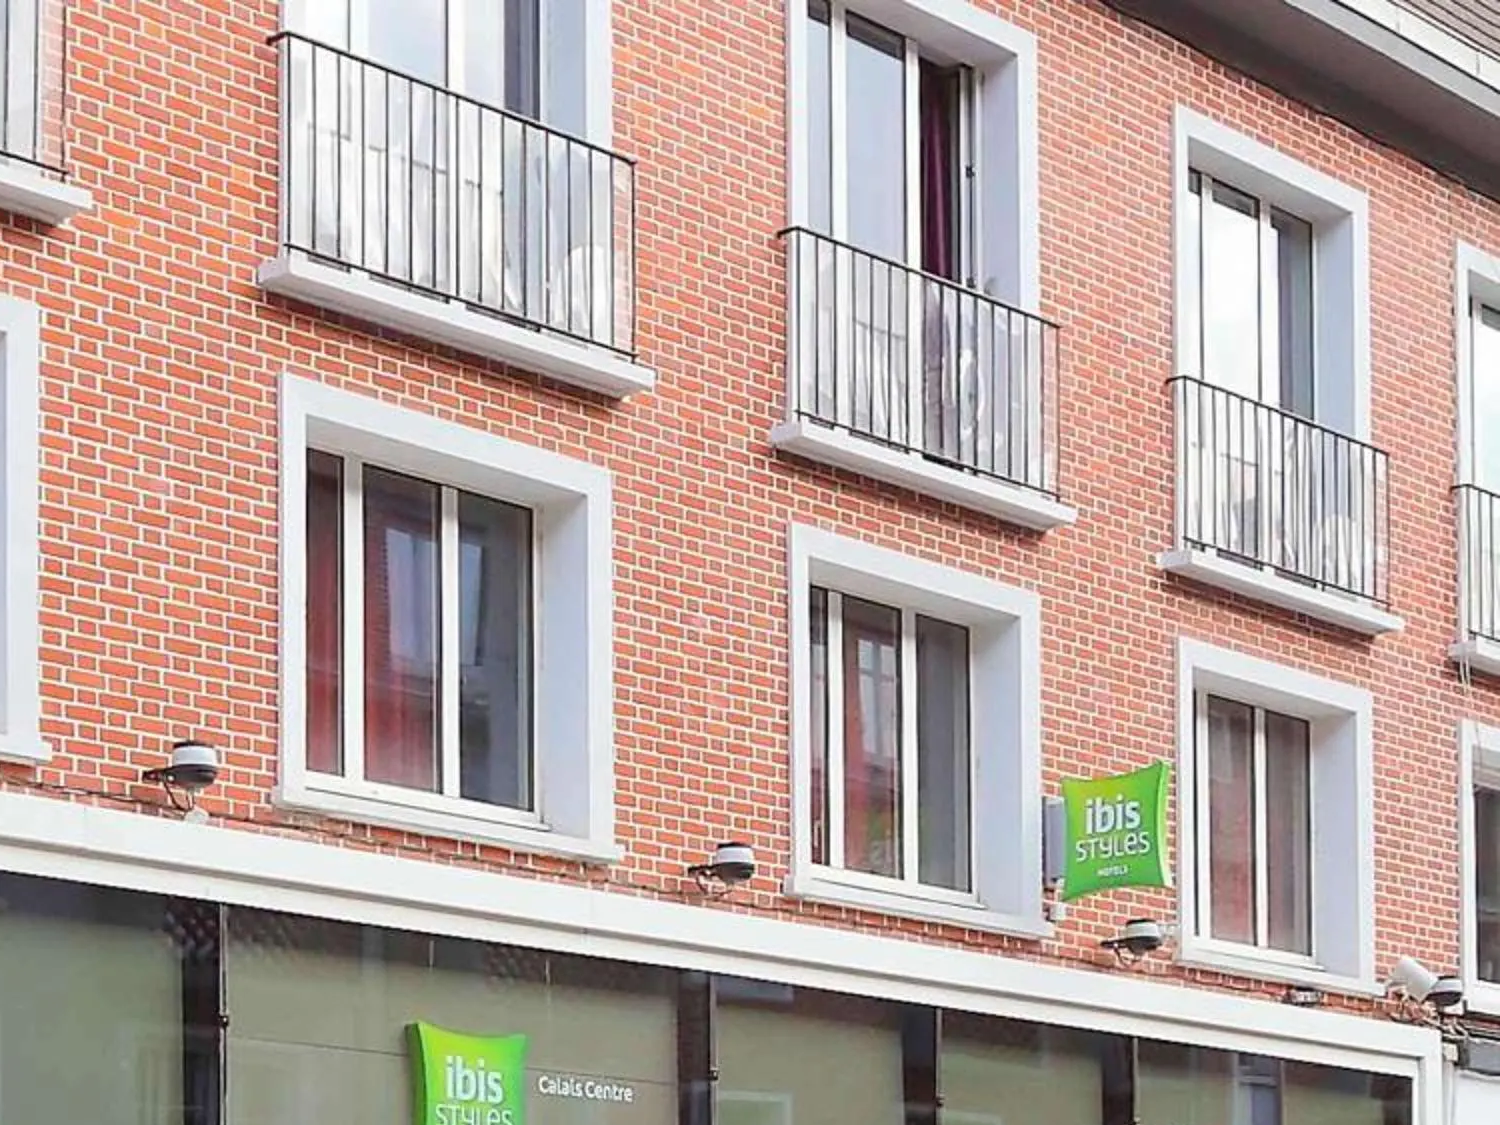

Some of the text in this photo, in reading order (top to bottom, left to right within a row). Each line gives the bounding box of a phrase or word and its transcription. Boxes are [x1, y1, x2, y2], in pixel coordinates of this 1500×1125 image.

[1084, 793, 1141, 834] ibis
[445, 1055, 504, 1105] ibis
[538, 1075, 634, 1103] Calais Centre
